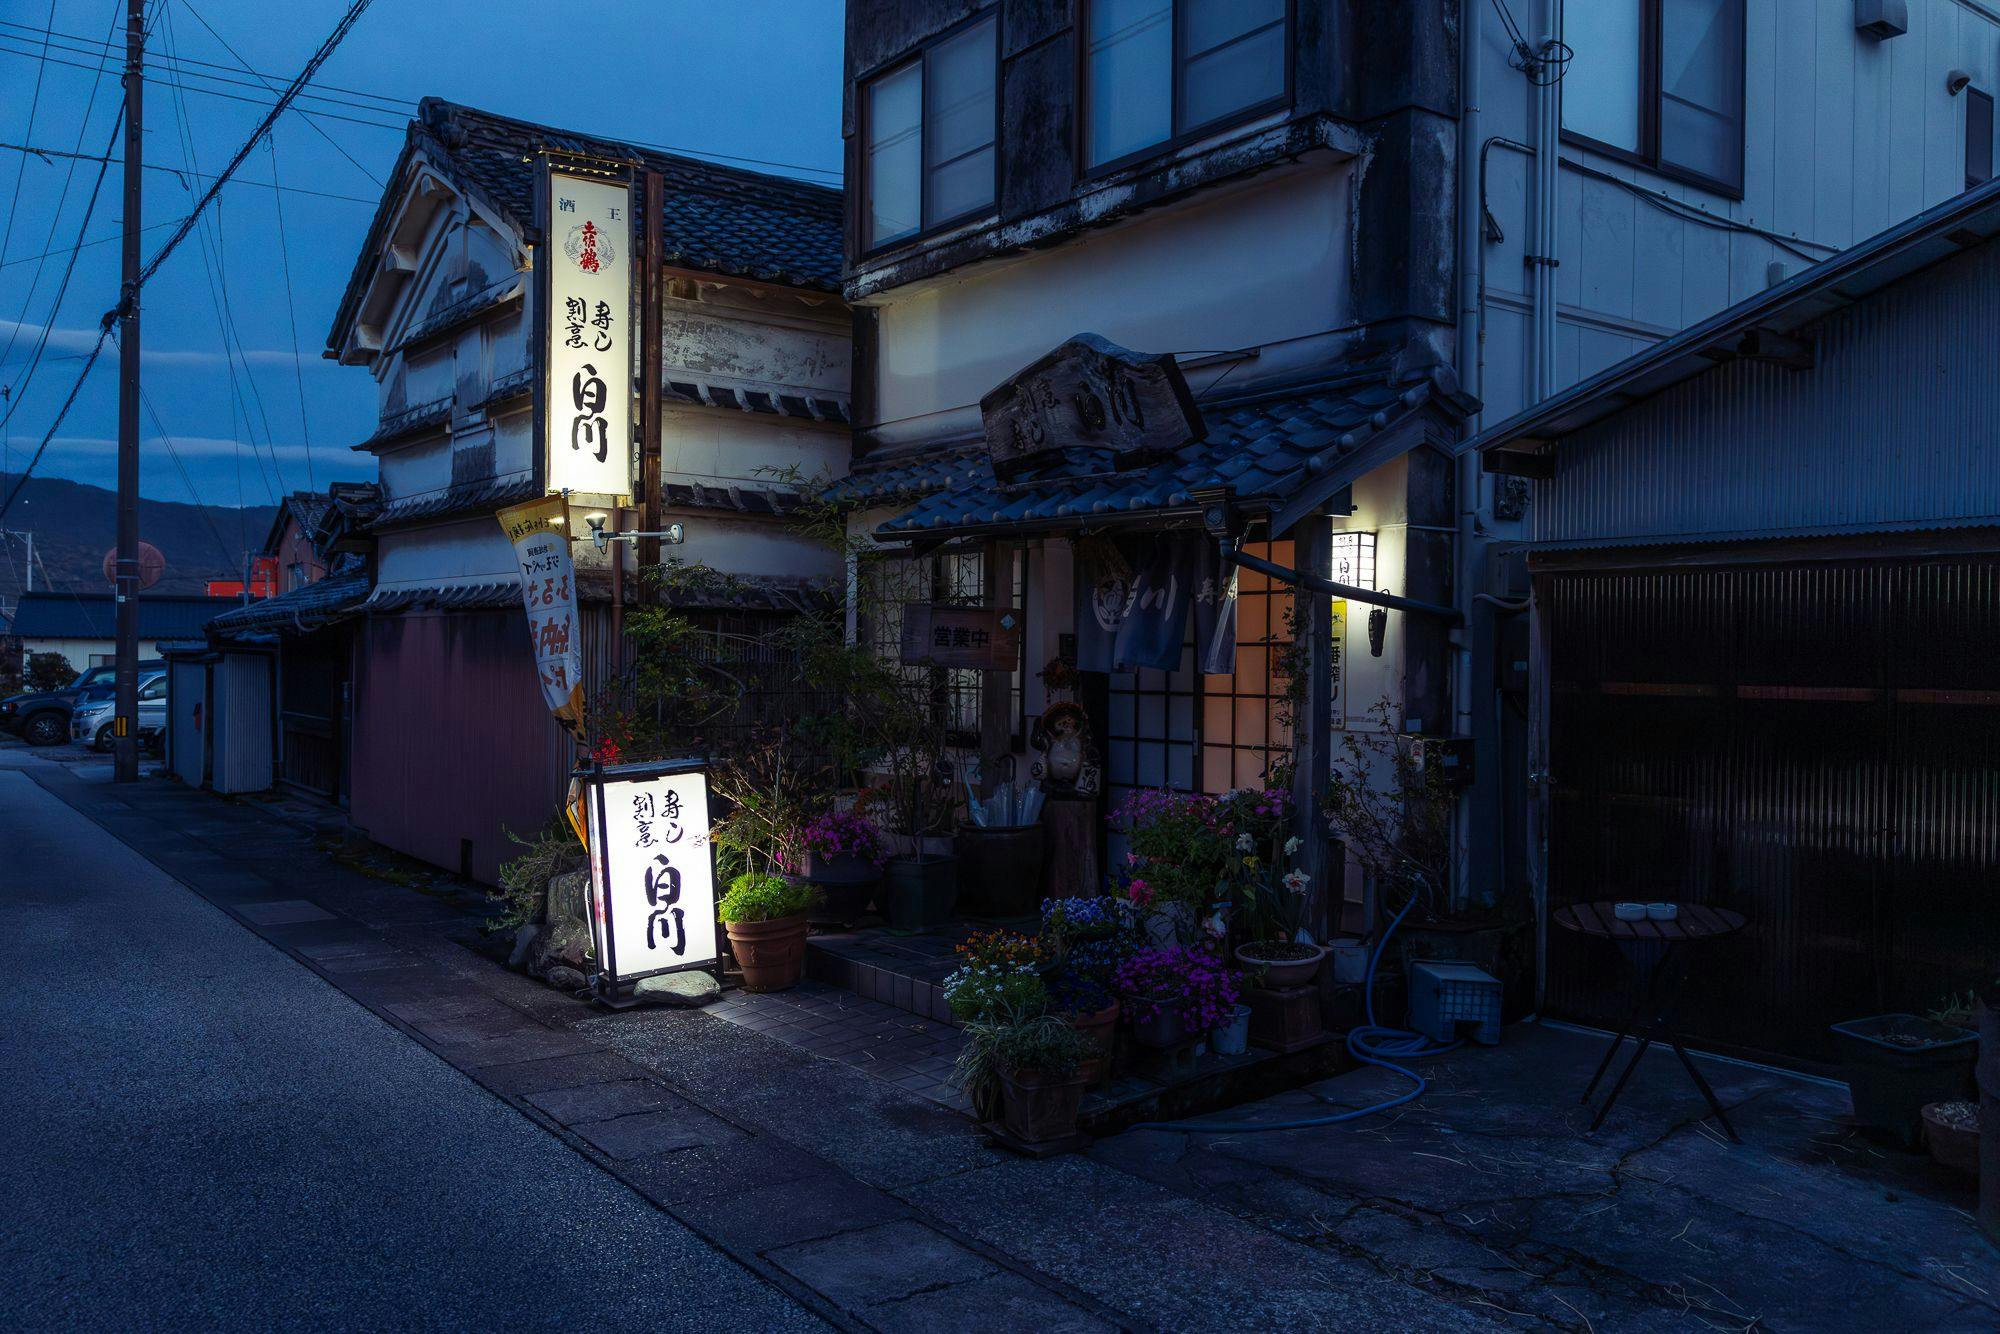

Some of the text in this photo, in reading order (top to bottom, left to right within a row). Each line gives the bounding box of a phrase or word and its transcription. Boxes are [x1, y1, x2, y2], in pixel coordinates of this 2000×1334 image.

[580, 220, 600, 274] 土佐鶴
[571, 363, 609, 464] 白川
[934, 625, 989, 649] 営業中
[644, 853, 687, 957] 白川
